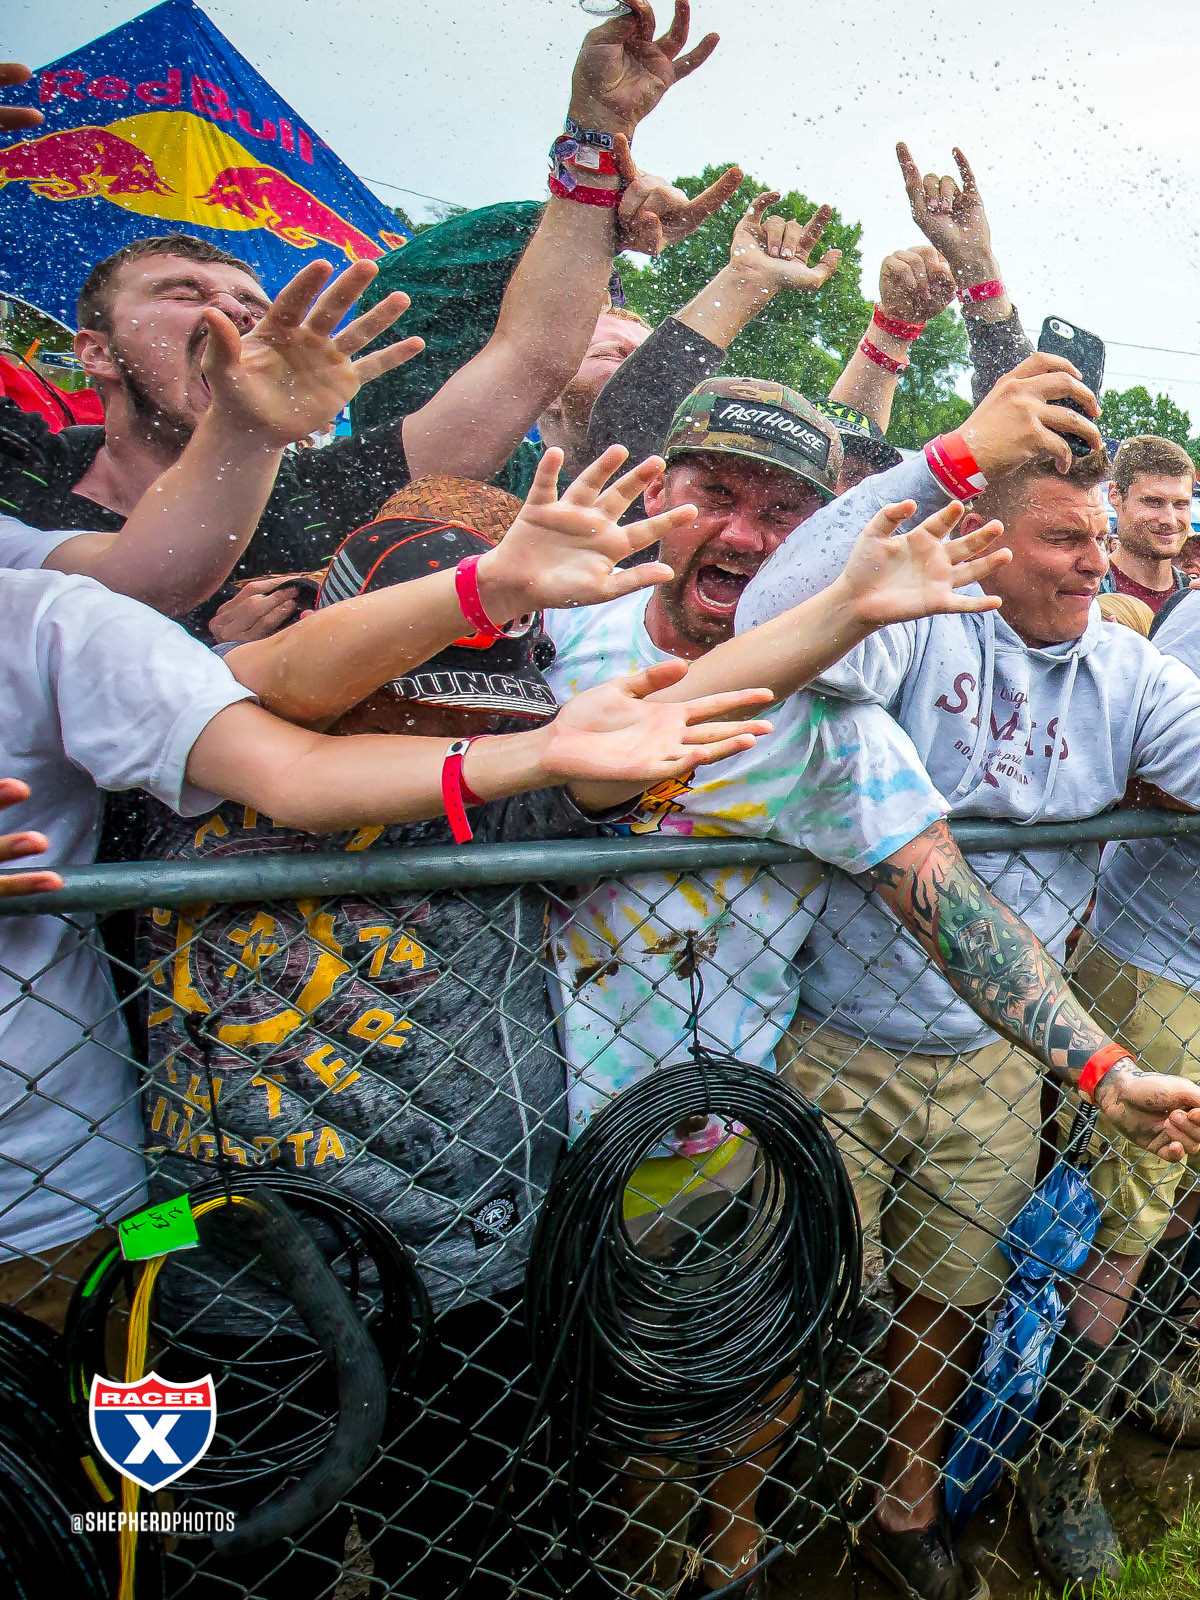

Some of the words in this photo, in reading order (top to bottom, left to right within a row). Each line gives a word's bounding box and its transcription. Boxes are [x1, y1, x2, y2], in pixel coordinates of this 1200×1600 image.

[39, 69, 181, 105] Red
[191, 74, 313, 165] Bull
[719, 404, 826, 450] FASTHOUSE
[359, 926, 426, 977] 74
